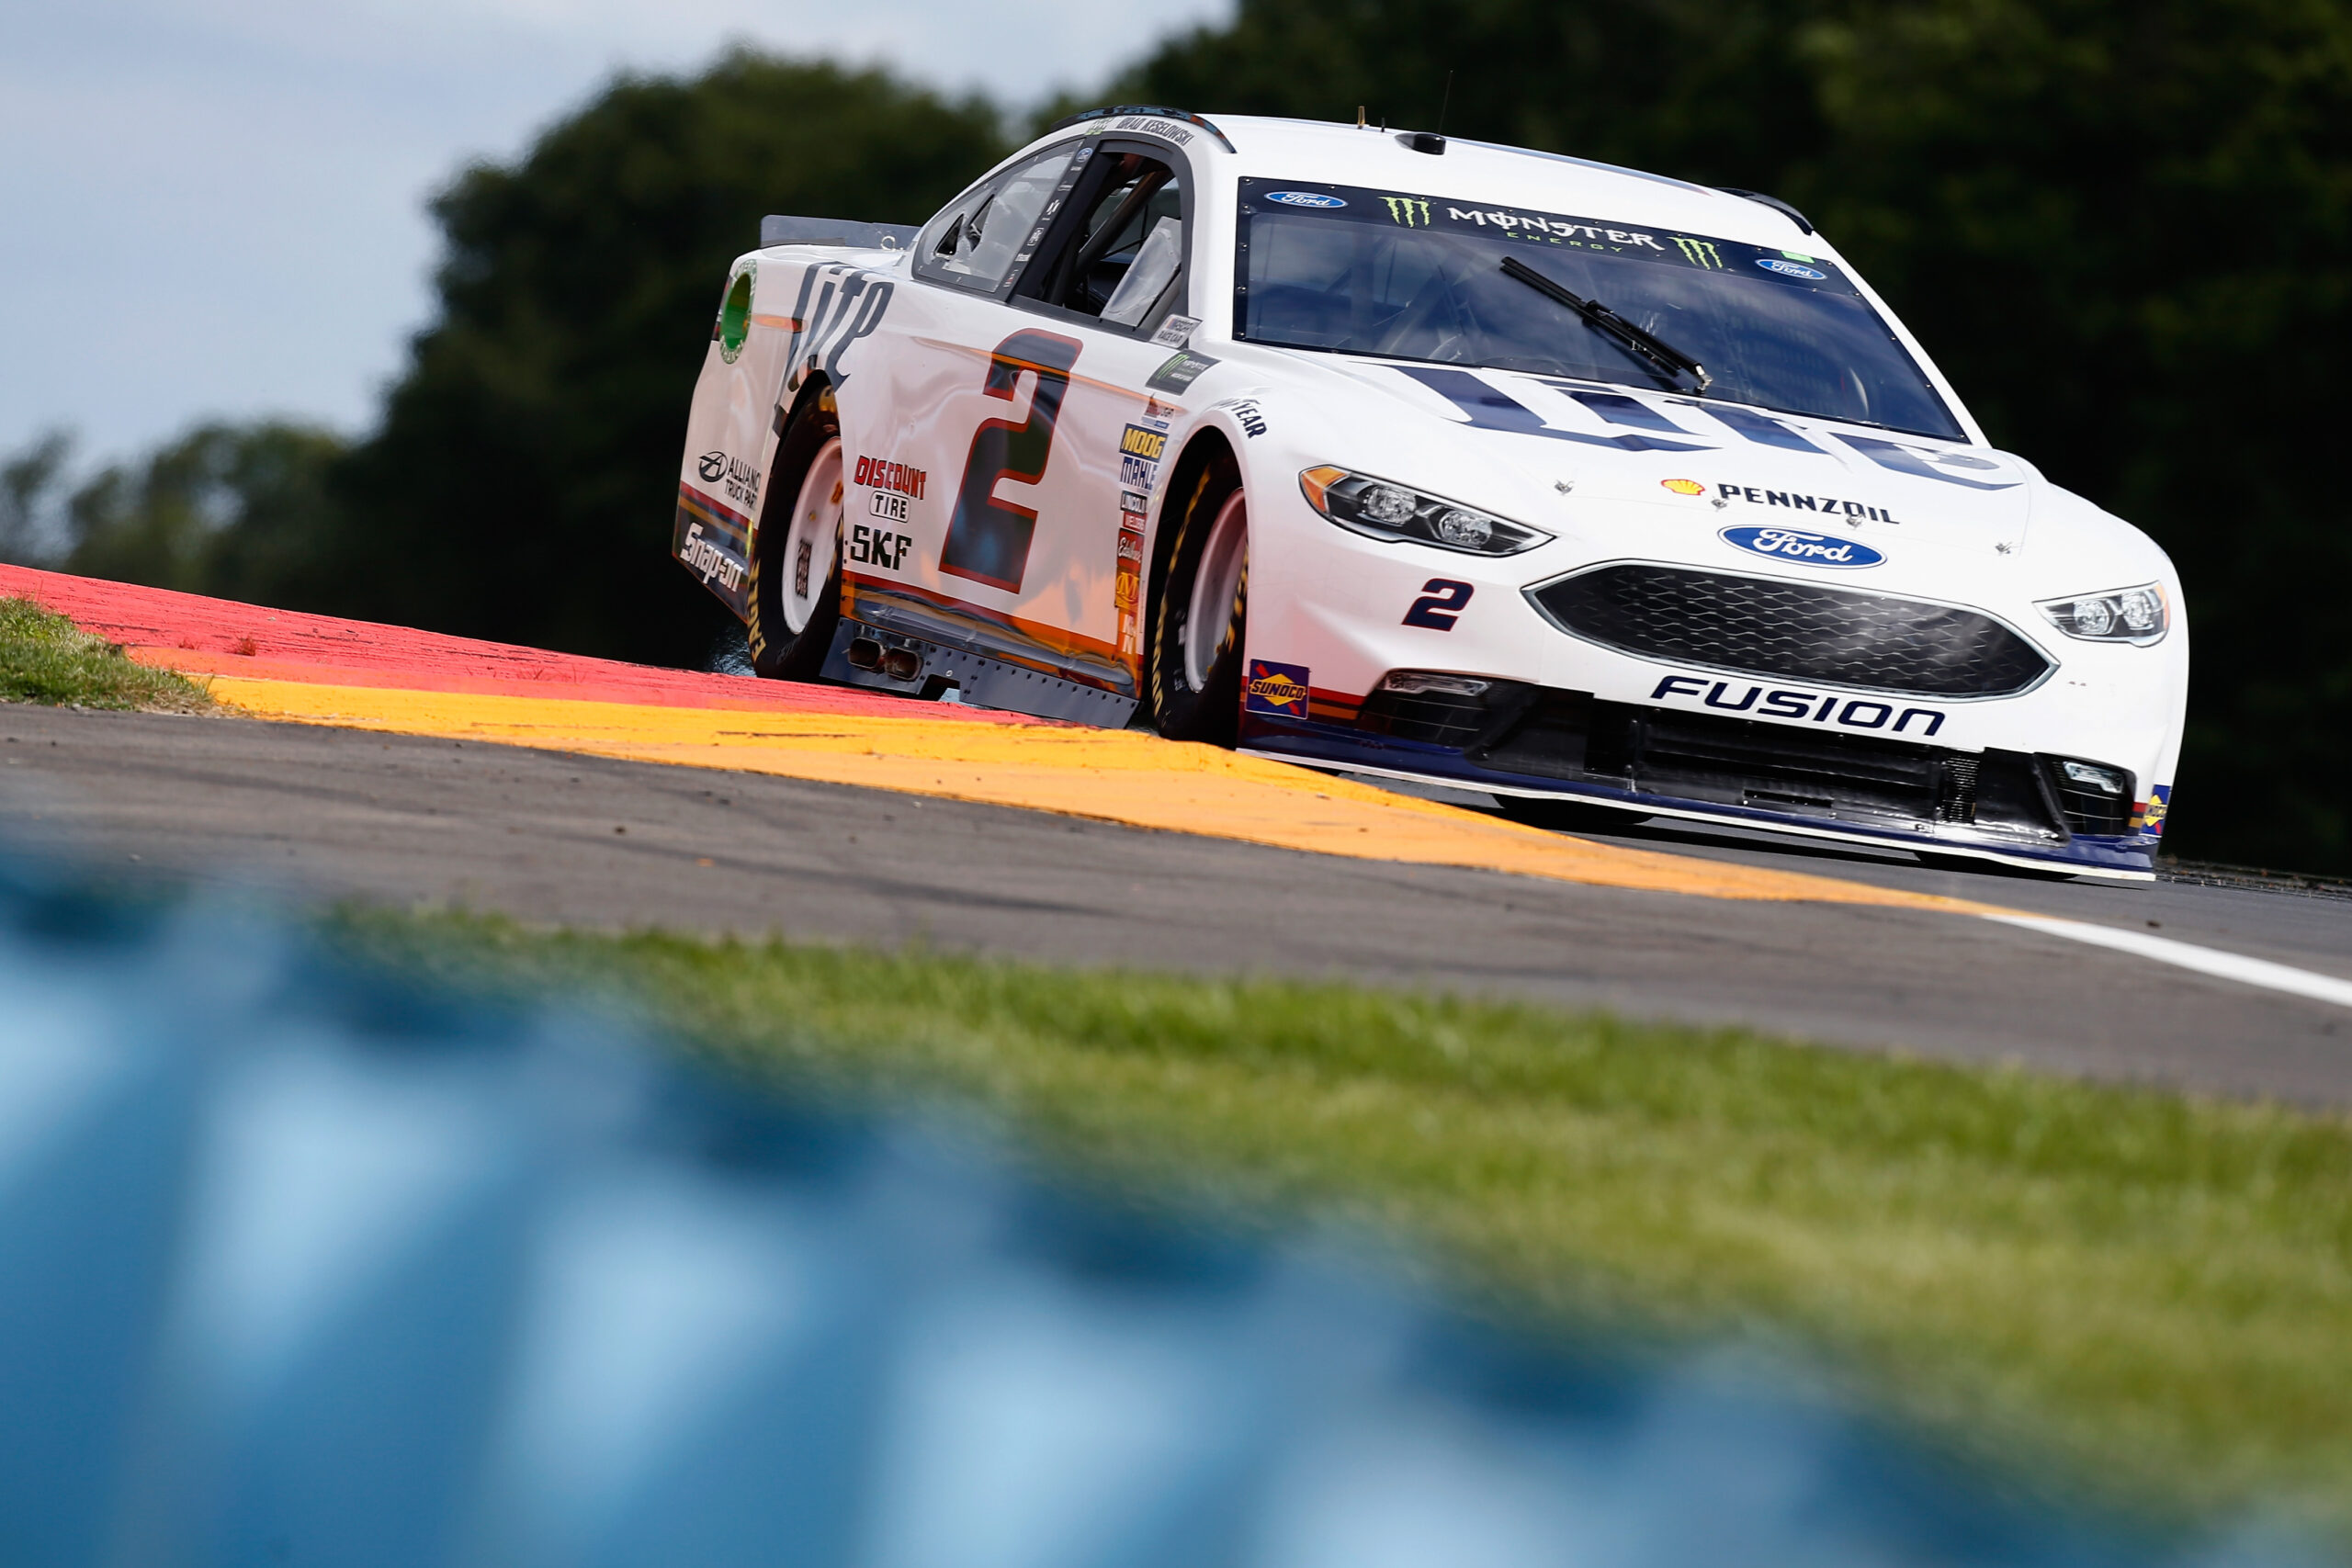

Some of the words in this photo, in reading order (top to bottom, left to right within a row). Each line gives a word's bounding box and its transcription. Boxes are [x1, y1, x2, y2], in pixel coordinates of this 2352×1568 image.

[1140, 119, 1194, 147] KESELOWSKI
[1281, 192, 1332, 208] Ford
[1446, 207, 1666, 252] MONSTER
[1507, 231, 1623, 254] ENERGY
[1770, 261, 1815, 278] Ford
[1121, 427, 1167, 459] MOOG
[728, 457, 762, 494] ALLIANC
[854, 455, 926, 501] DISCOUNT
[938, 327, 1084, 595] 2
[1120, 456, 1158, 491] MAHLE
[725, 478, 745, 502] TRUCK
[875, 494, 907, 520] TIRE
[1716, 482, 1901, 525] PENNZOIL
[680, 522, 744, 592] Snap-on
[850, 524, 911, 570] SKF
[1752, 528, 1853, 563] Ford
[1402, 578, 1476, 633] 2
[1251, 681, 1305, 699] SUNOCO
[1650, 675, 1946, 737] FUSION
